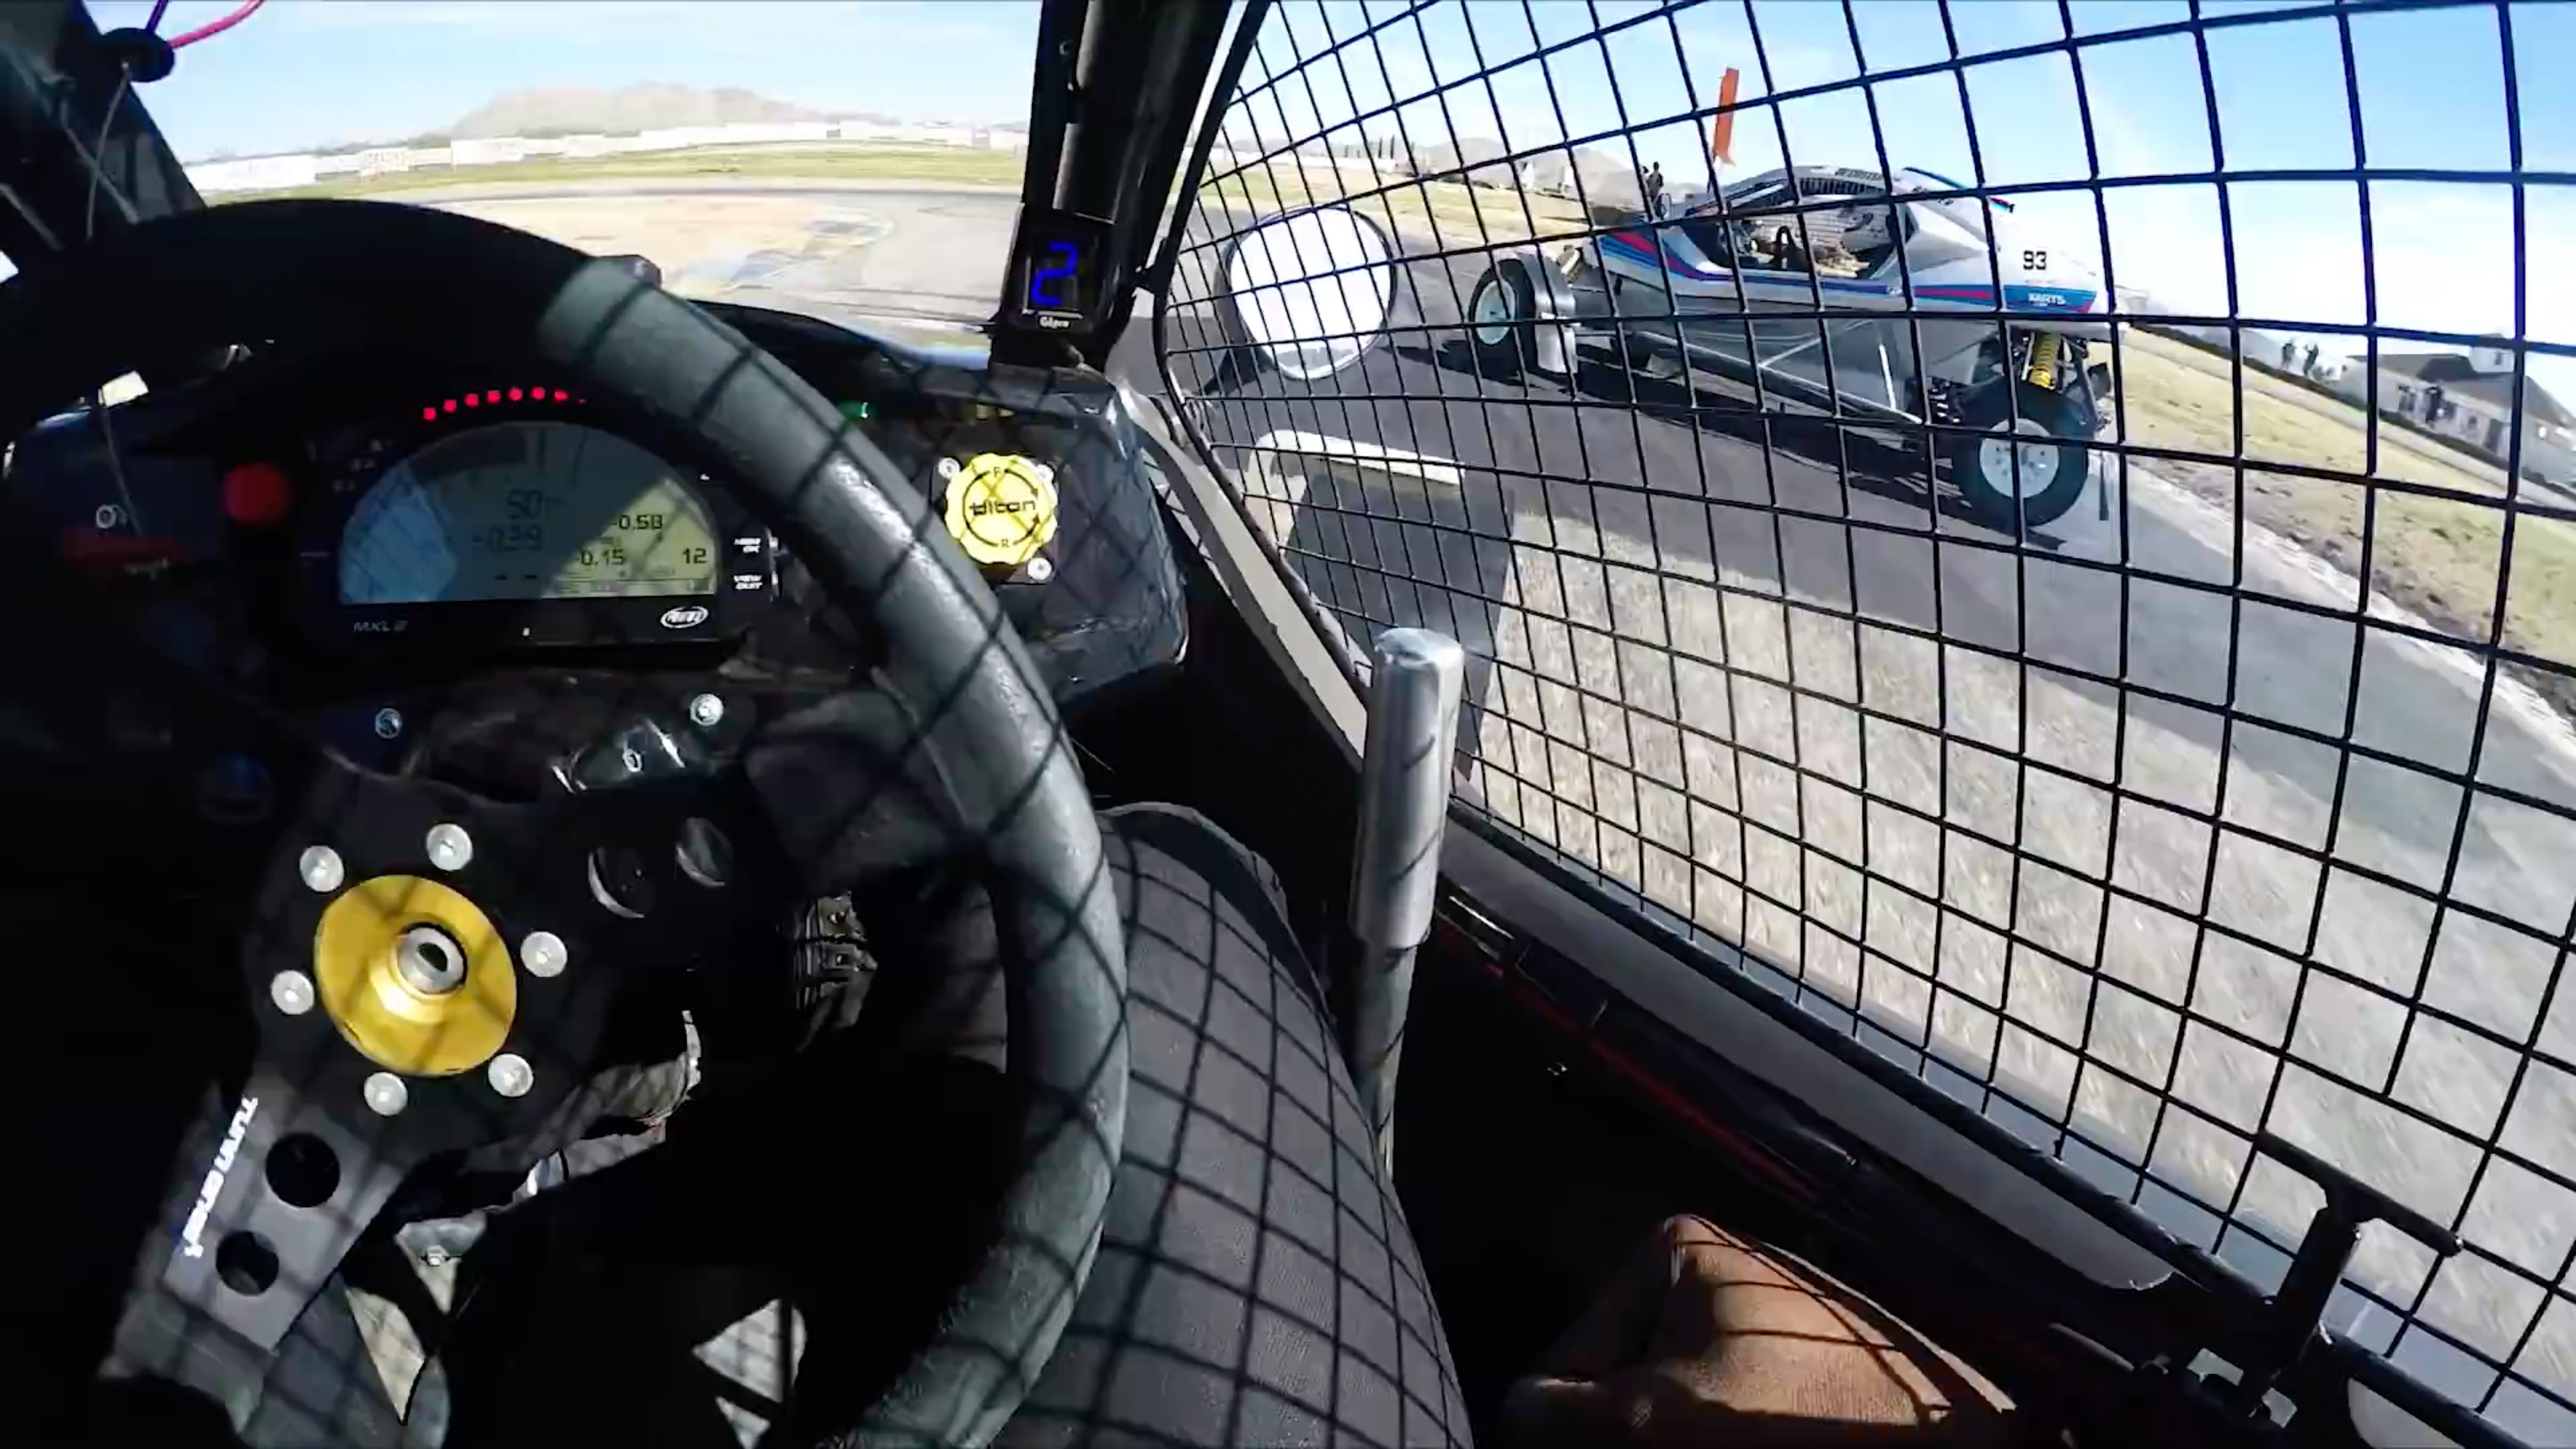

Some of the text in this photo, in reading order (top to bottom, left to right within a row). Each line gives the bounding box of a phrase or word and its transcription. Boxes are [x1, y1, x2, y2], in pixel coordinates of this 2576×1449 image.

[2023, 250, 2046, 270] 93
[1030, 241, 1079, 306] 2
[682, 548, 707, 564] 12
